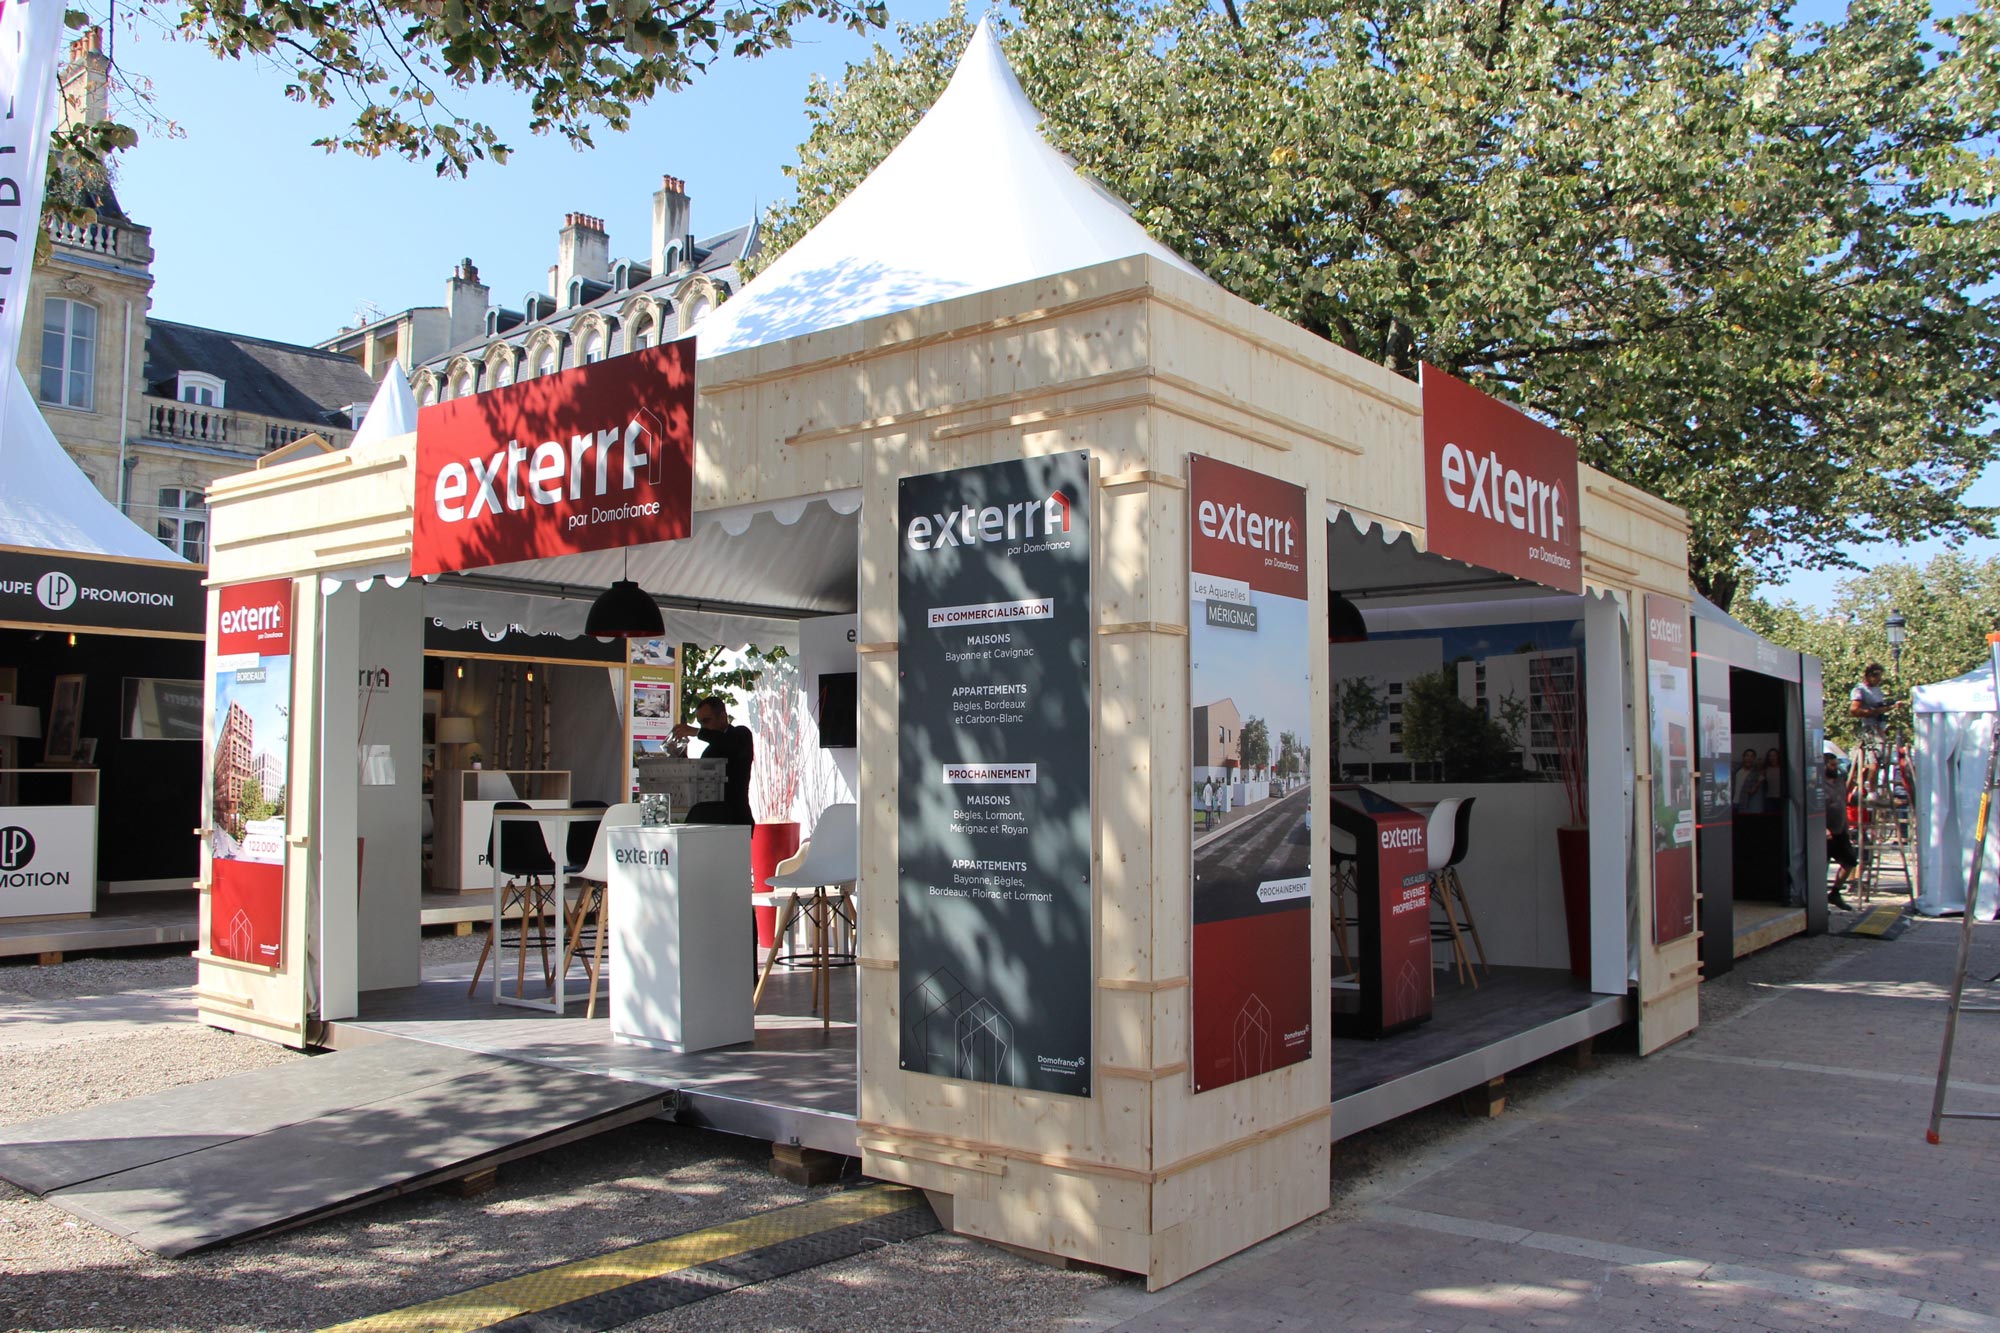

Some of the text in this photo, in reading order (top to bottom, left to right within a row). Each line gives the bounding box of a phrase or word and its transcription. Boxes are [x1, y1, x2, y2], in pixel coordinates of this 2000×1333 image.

[568, 501, 660, 530] par Domofrance
[1007, 540, 1071, 557] par Domofrance
[1264, 557, 1299, 572] par Domofrance
[1529, 546, 1571, 570] par Domofrance
[0, 581, 33, 595] UPE
[80, 587, 174, 607] PROMOTION
[1194, 580, 1246, 601] Les Aquarelles
[932, 604, 1049, 623] EN COMMERCIALISATION
[1208, 605, 1256, 627] MÉRIGNAC
[967, 633, 1011, 646] MAISONS
[945, 647, 1034, 662] Bayonne et Cavignac
[236, 672, 266, 682] BORDEAUX
[952, 684, 1027, 697] APPARTEMENTS
[953, 700, 1026, 712] Bègles, Bordeaux
[955, 713, 1024, 725] et Carbon-Blanc
[948, 769, 1031, 779] PROCHAINEMENT
[966, 795, 1011, 805] MAISONS
[953, 810, 1025, 821] Bègles, Lormont,
[950, 823, 1029, 836] Mérignac et Royan
[952, 859, 1027, 872] APPARTEMENTS
[953, 874, 1025, 888] Bayonne, Bègles,
[929, 886, 1053, 902] Bordeaux, Floirac et Lormont
[1259, 883, 1307, 898] PROCHAINEMENT
[1402, 886, 1426, 900] DEVENEZ
[1392, 896, 1427, 915] PROPRIÉTAIRE
[1037, 1055, 1079, 1068] Domofrance
